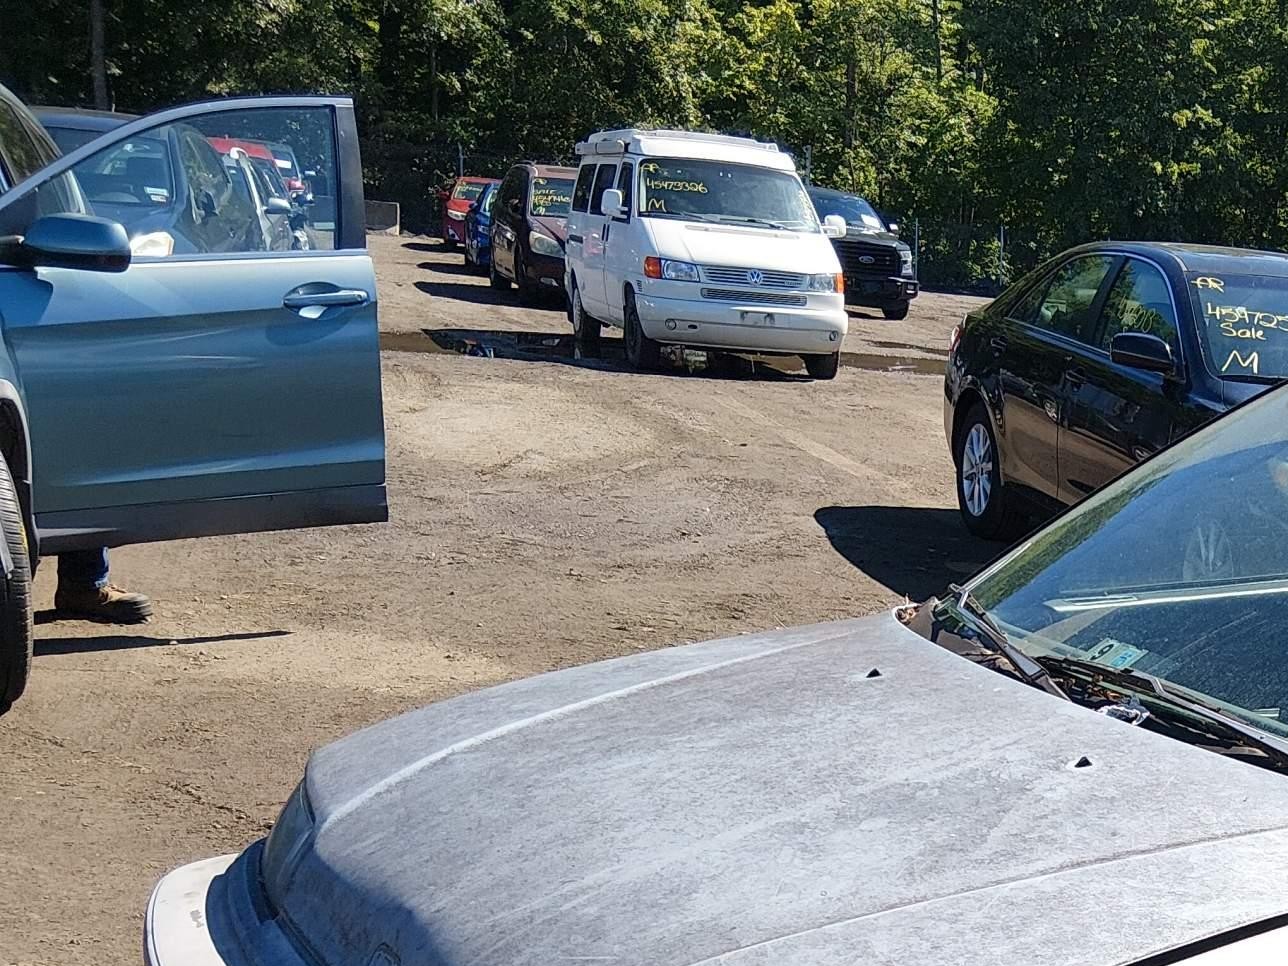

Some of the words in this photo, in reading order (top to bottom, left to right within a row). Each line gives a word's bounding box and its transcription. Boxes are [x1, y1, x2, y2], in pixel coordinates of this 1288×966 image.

[648, 198, 667, 212] M
[1220, 322, 1267, 341] Sale
[1221, 350, 1259, 374] M
